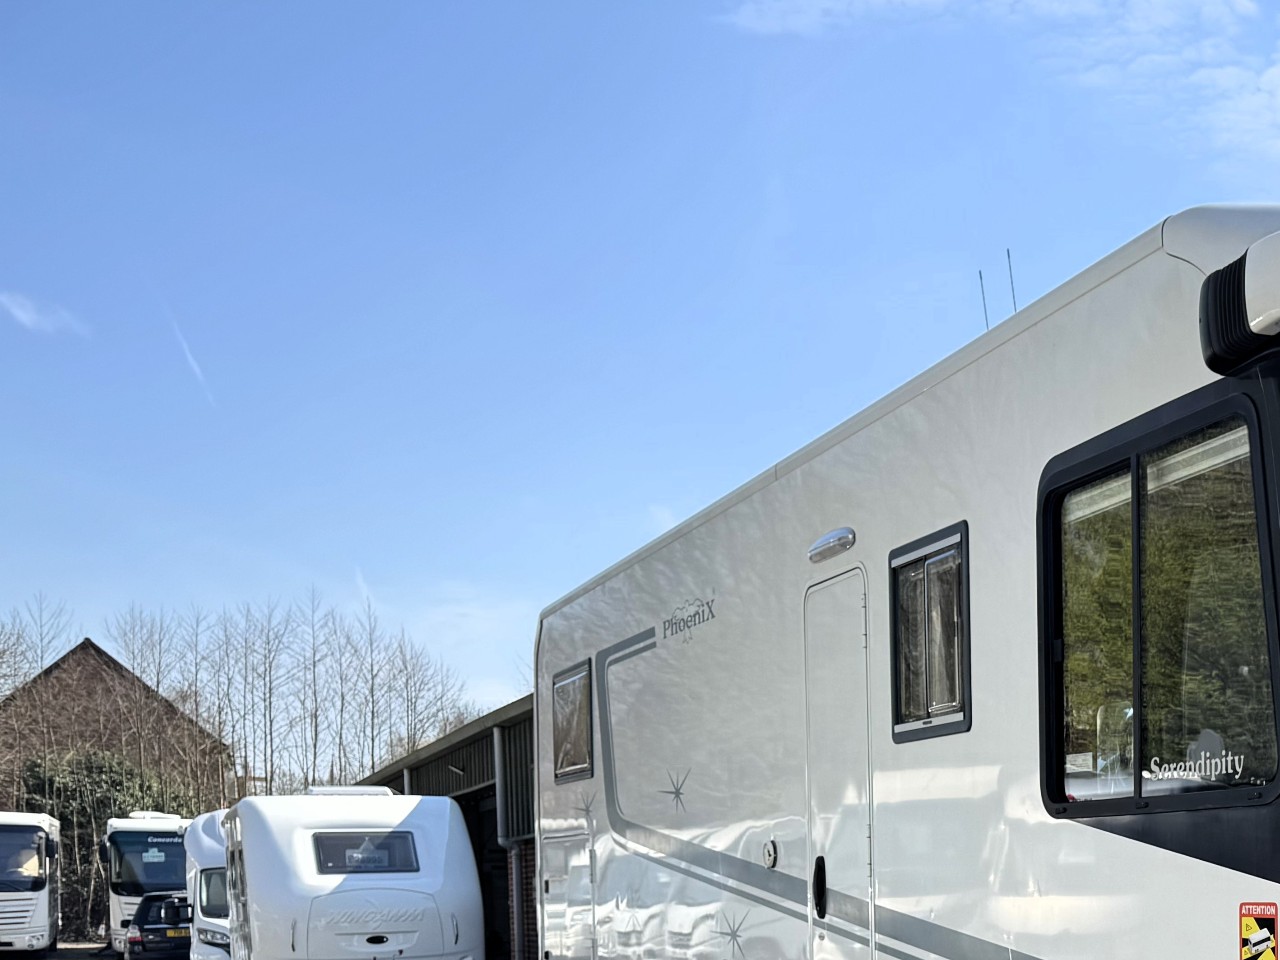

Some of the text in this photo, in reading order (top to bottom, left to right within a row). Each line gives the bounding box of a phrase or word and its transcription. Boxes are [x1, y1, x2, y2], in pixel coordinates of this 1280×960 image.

[662, 597, 716, 640] PhoeniX
[1150, 749, 1246, 782] Serendipity
[1241, 905, 1276, 915] ATTENTION
